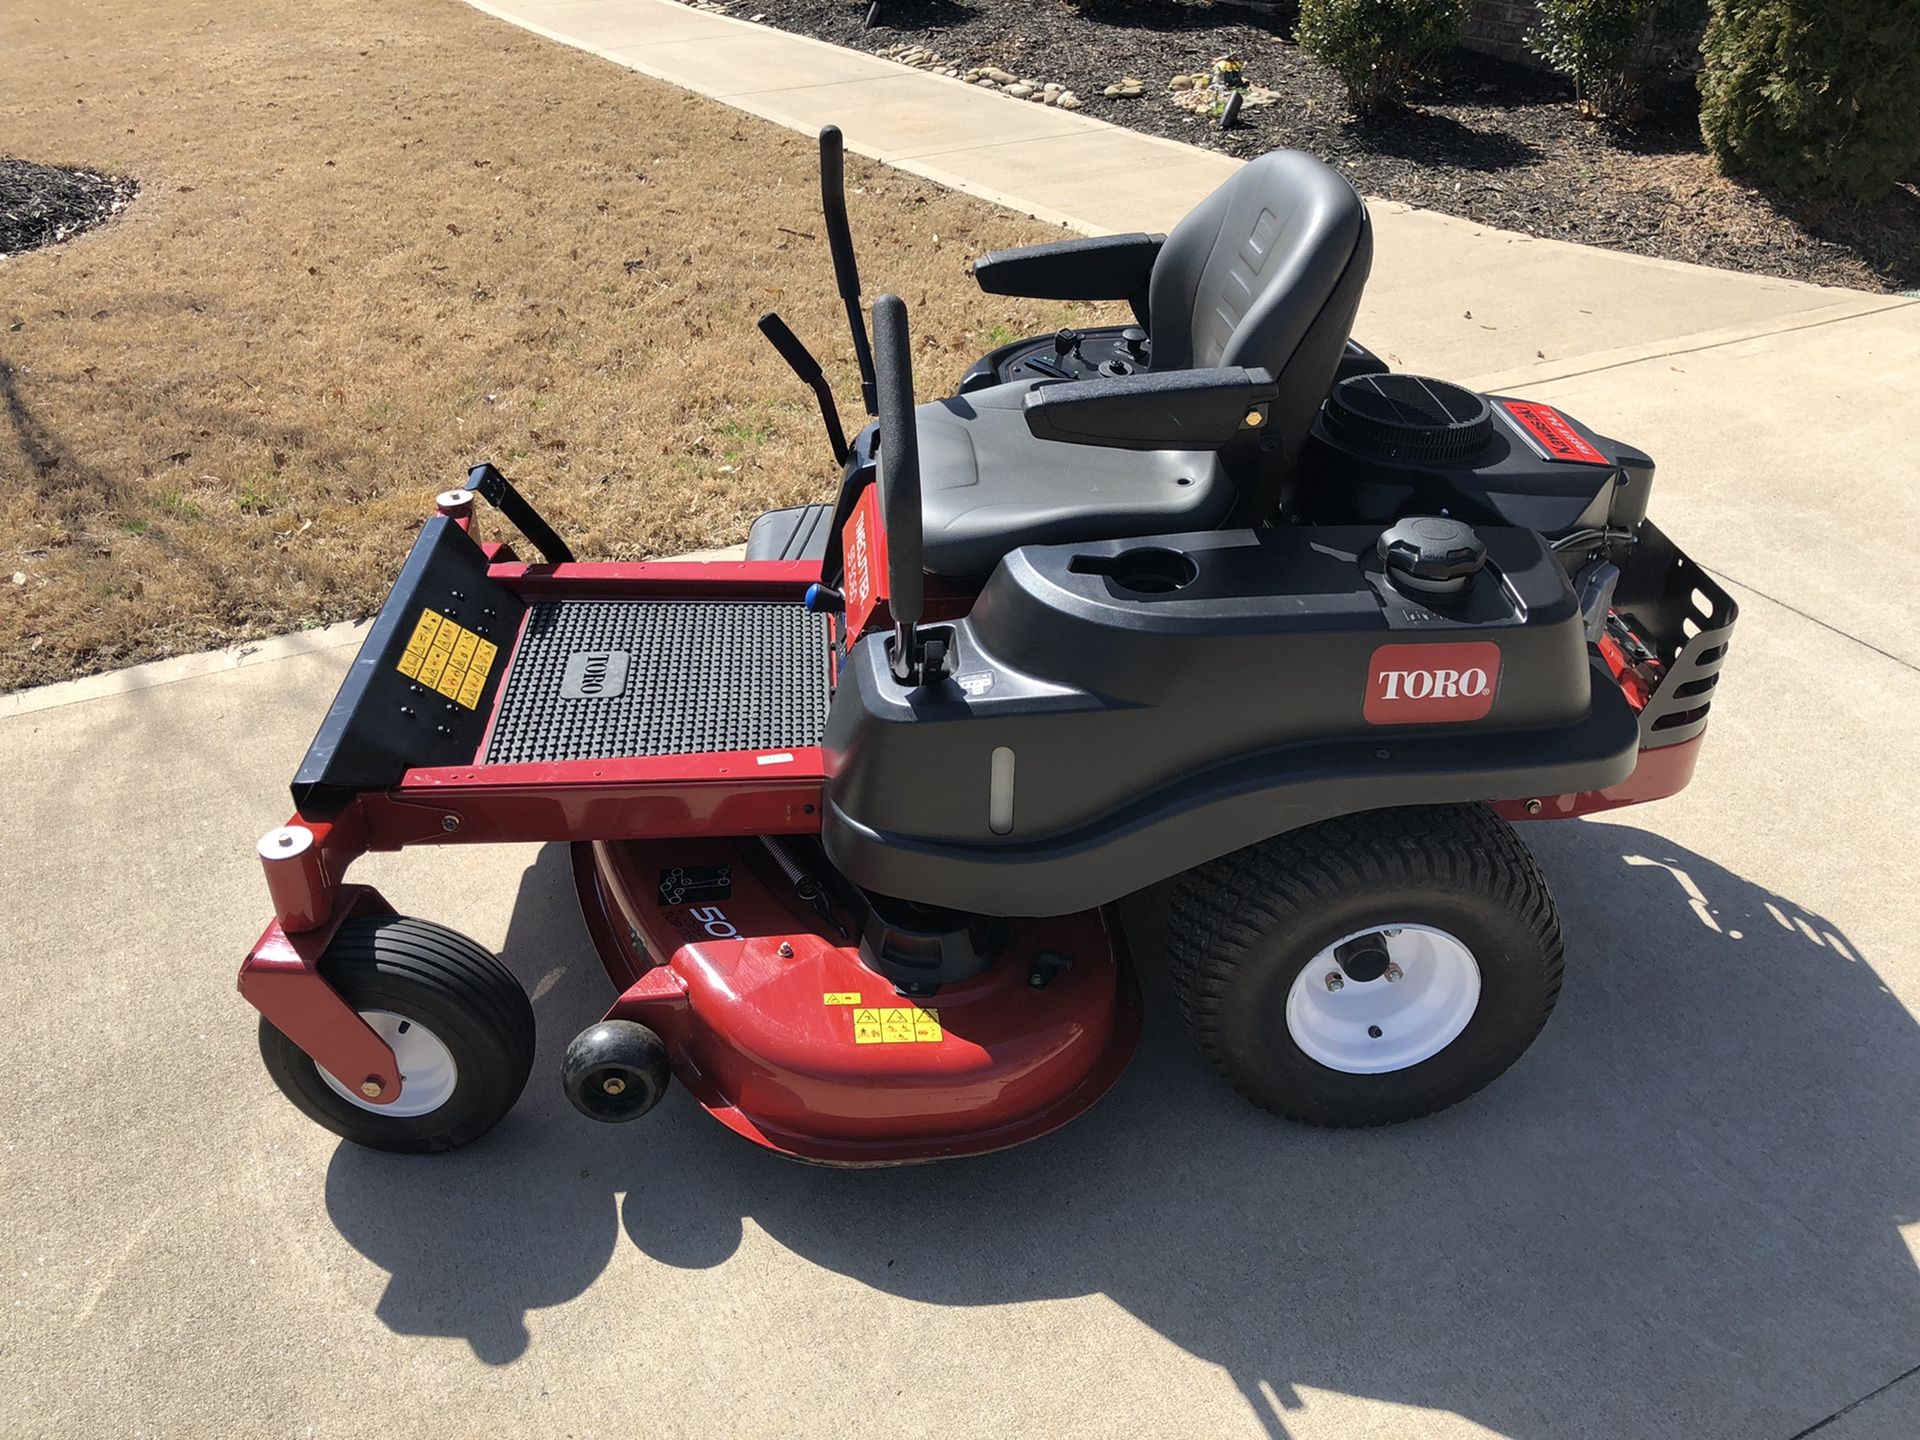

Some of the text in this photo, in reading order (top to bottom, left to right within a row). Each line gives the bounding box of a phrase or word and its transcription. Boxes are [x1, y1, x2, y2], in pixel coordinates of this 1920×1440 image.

[1511, 404, 1575, 455] Kawasaki
[855, 510, 870, 606] TIMECUTTER
[581, 654, 609, 694] TORO
[1378, 667, 1488, 700] TORO
